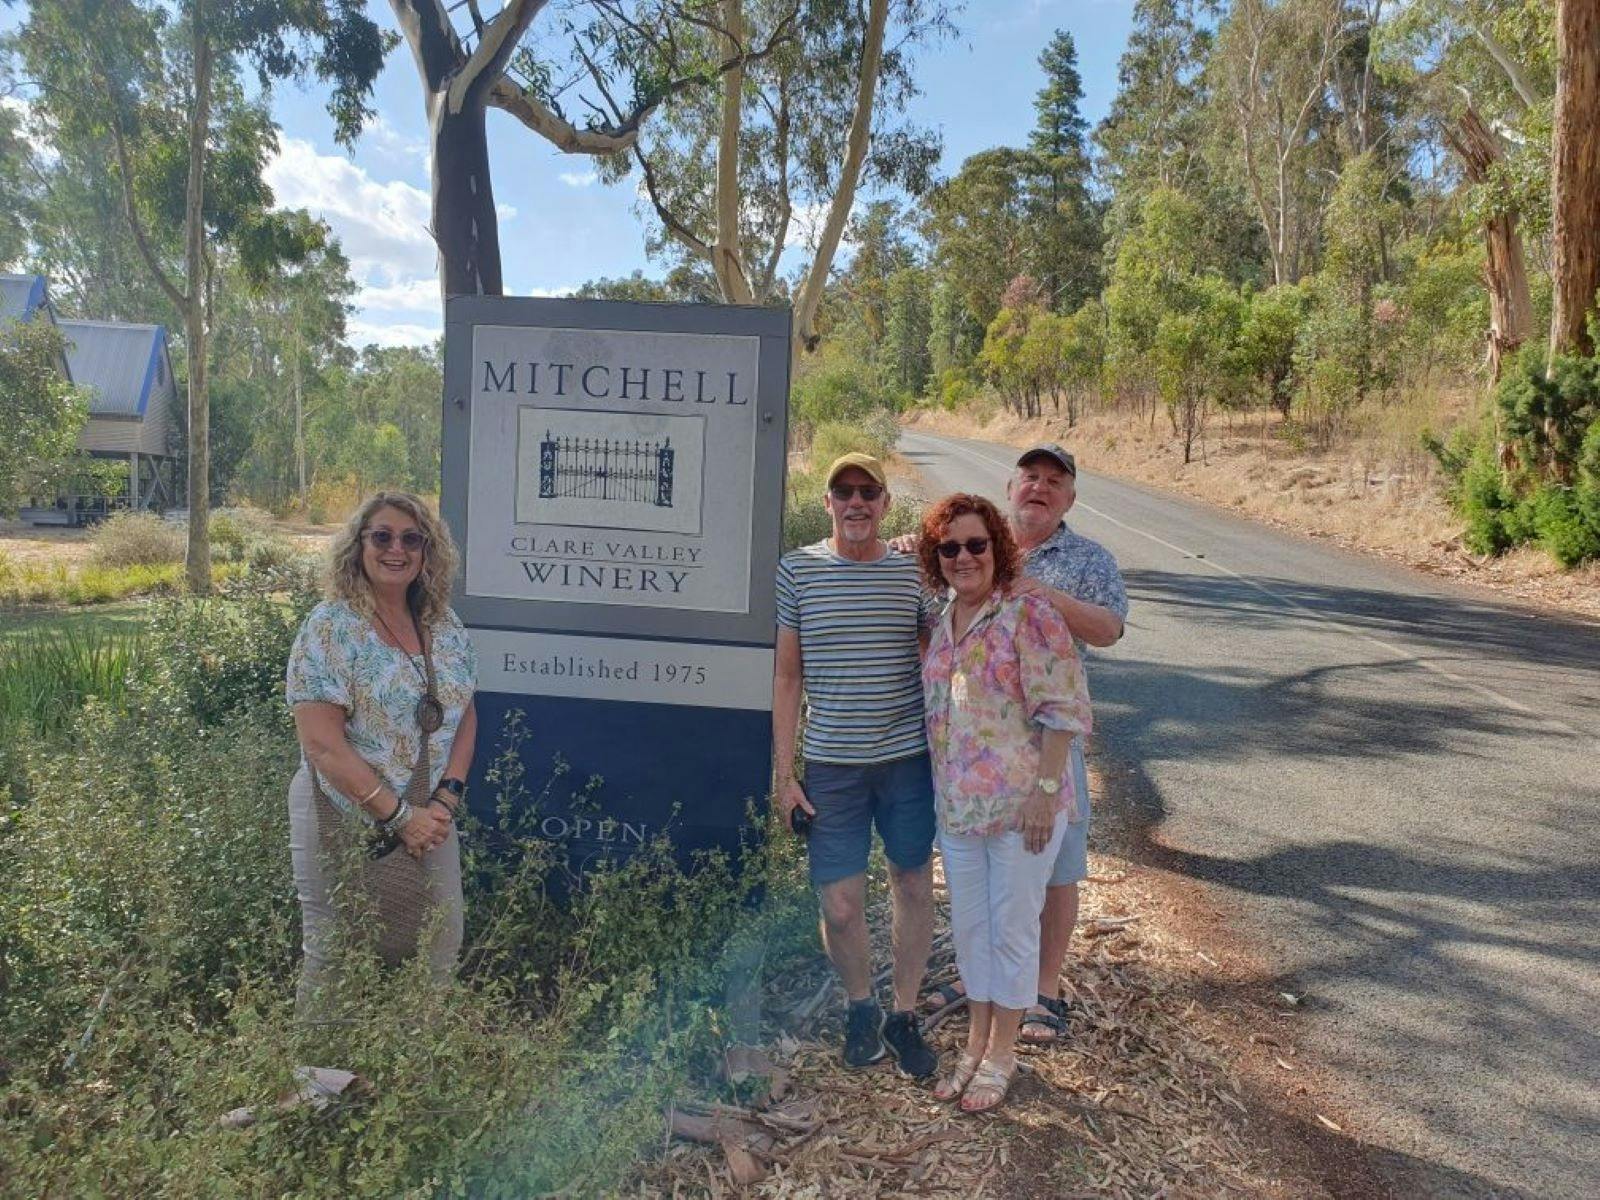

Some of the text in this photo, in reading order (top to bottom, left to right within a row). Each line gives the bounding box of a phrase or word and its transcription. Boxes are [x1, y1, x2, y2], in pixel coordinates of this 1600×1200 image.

[481, 361, 748, 406] MITCHELL
[511, 537, 701, 562] CLARE VALLEY
[521, 561, 690, 593] WINERY
[503, 653, 706, 685] Established 1975
[541, 816, 647, 842] OPEN
